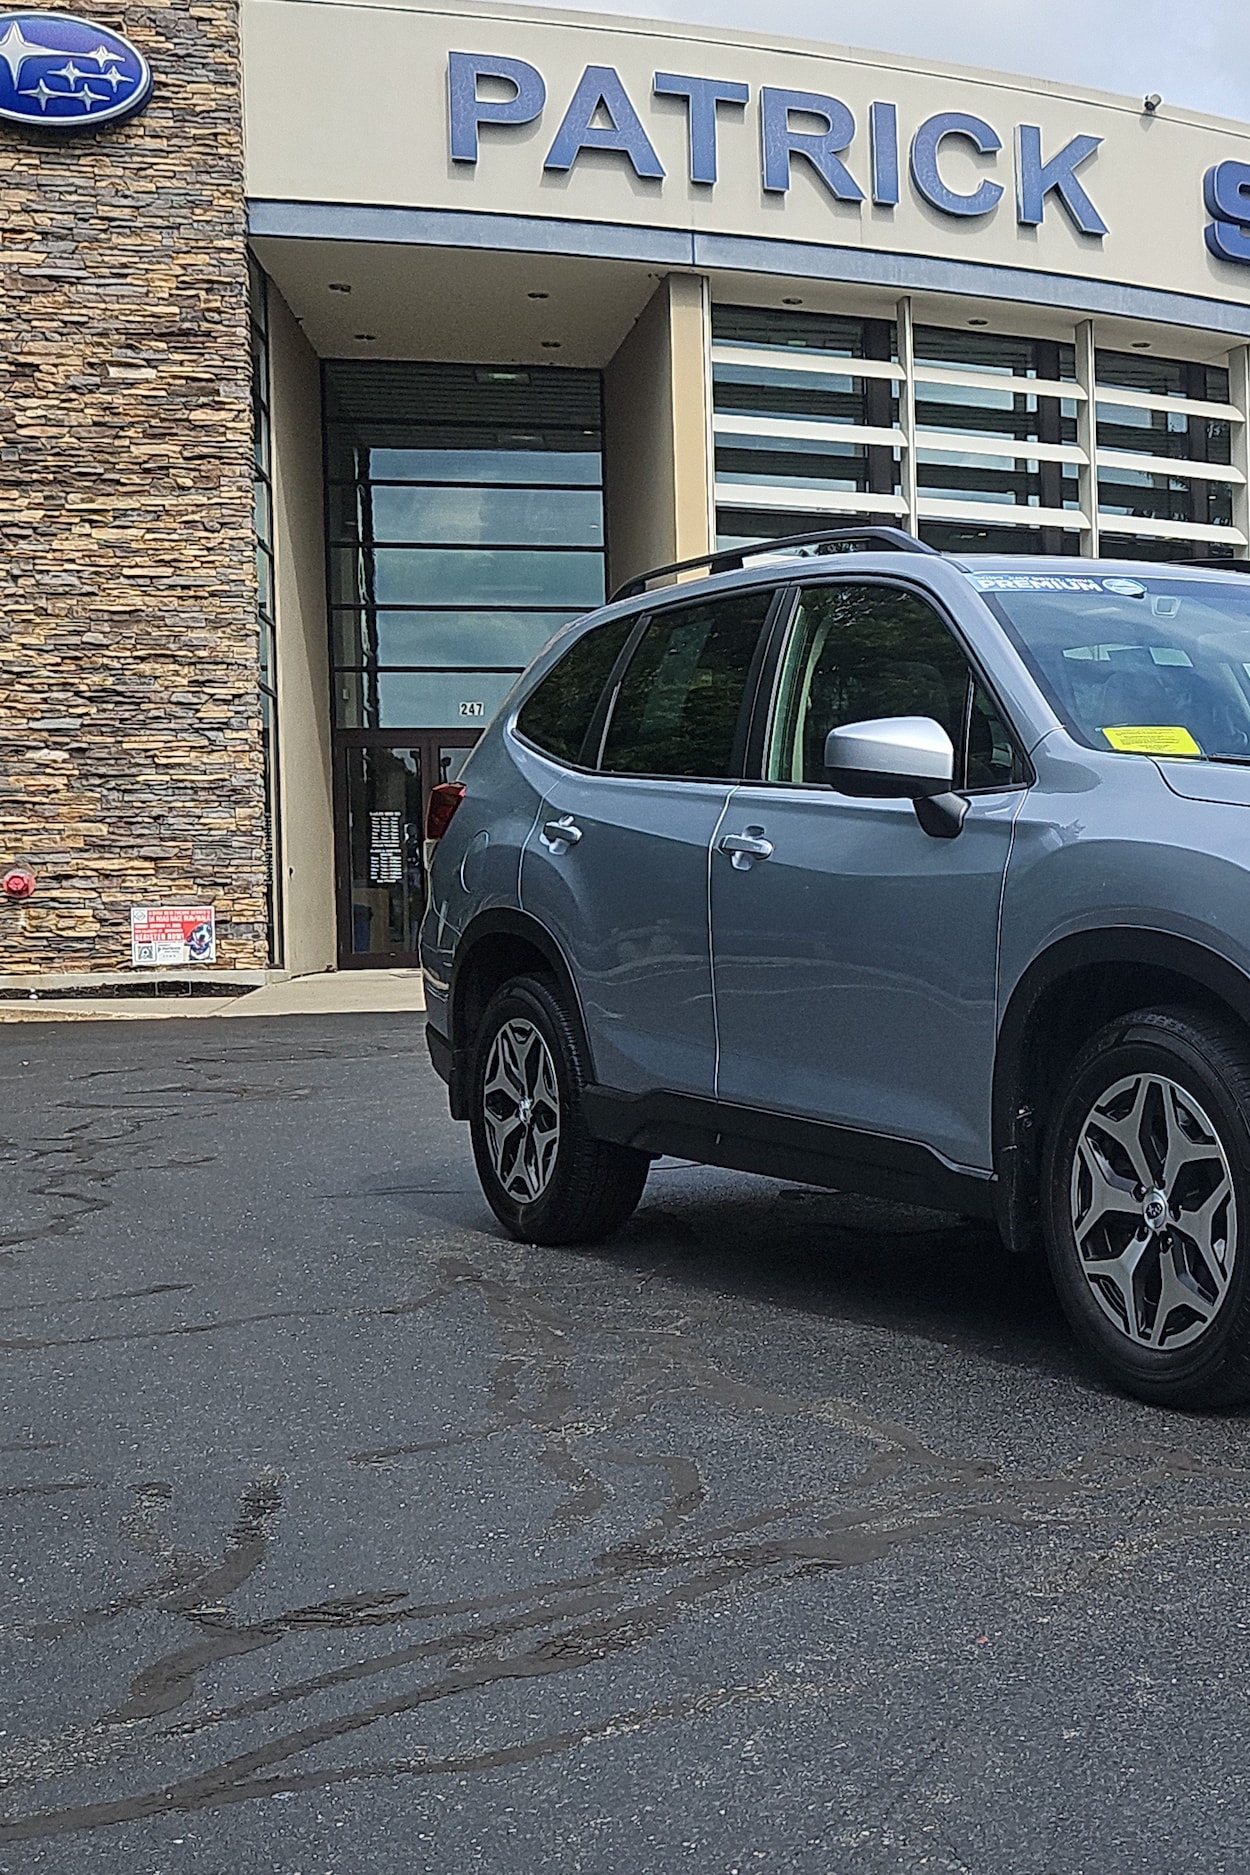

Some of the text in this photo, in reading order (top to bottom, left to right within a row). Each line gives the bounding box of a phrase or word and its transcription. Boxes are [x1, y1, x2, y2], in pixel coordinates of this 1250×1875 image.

[446, 50, 1110, 236] PATRICK
[977, 579, 1104, 592] PREMIUM
[460, 703, 482, 716] 247
